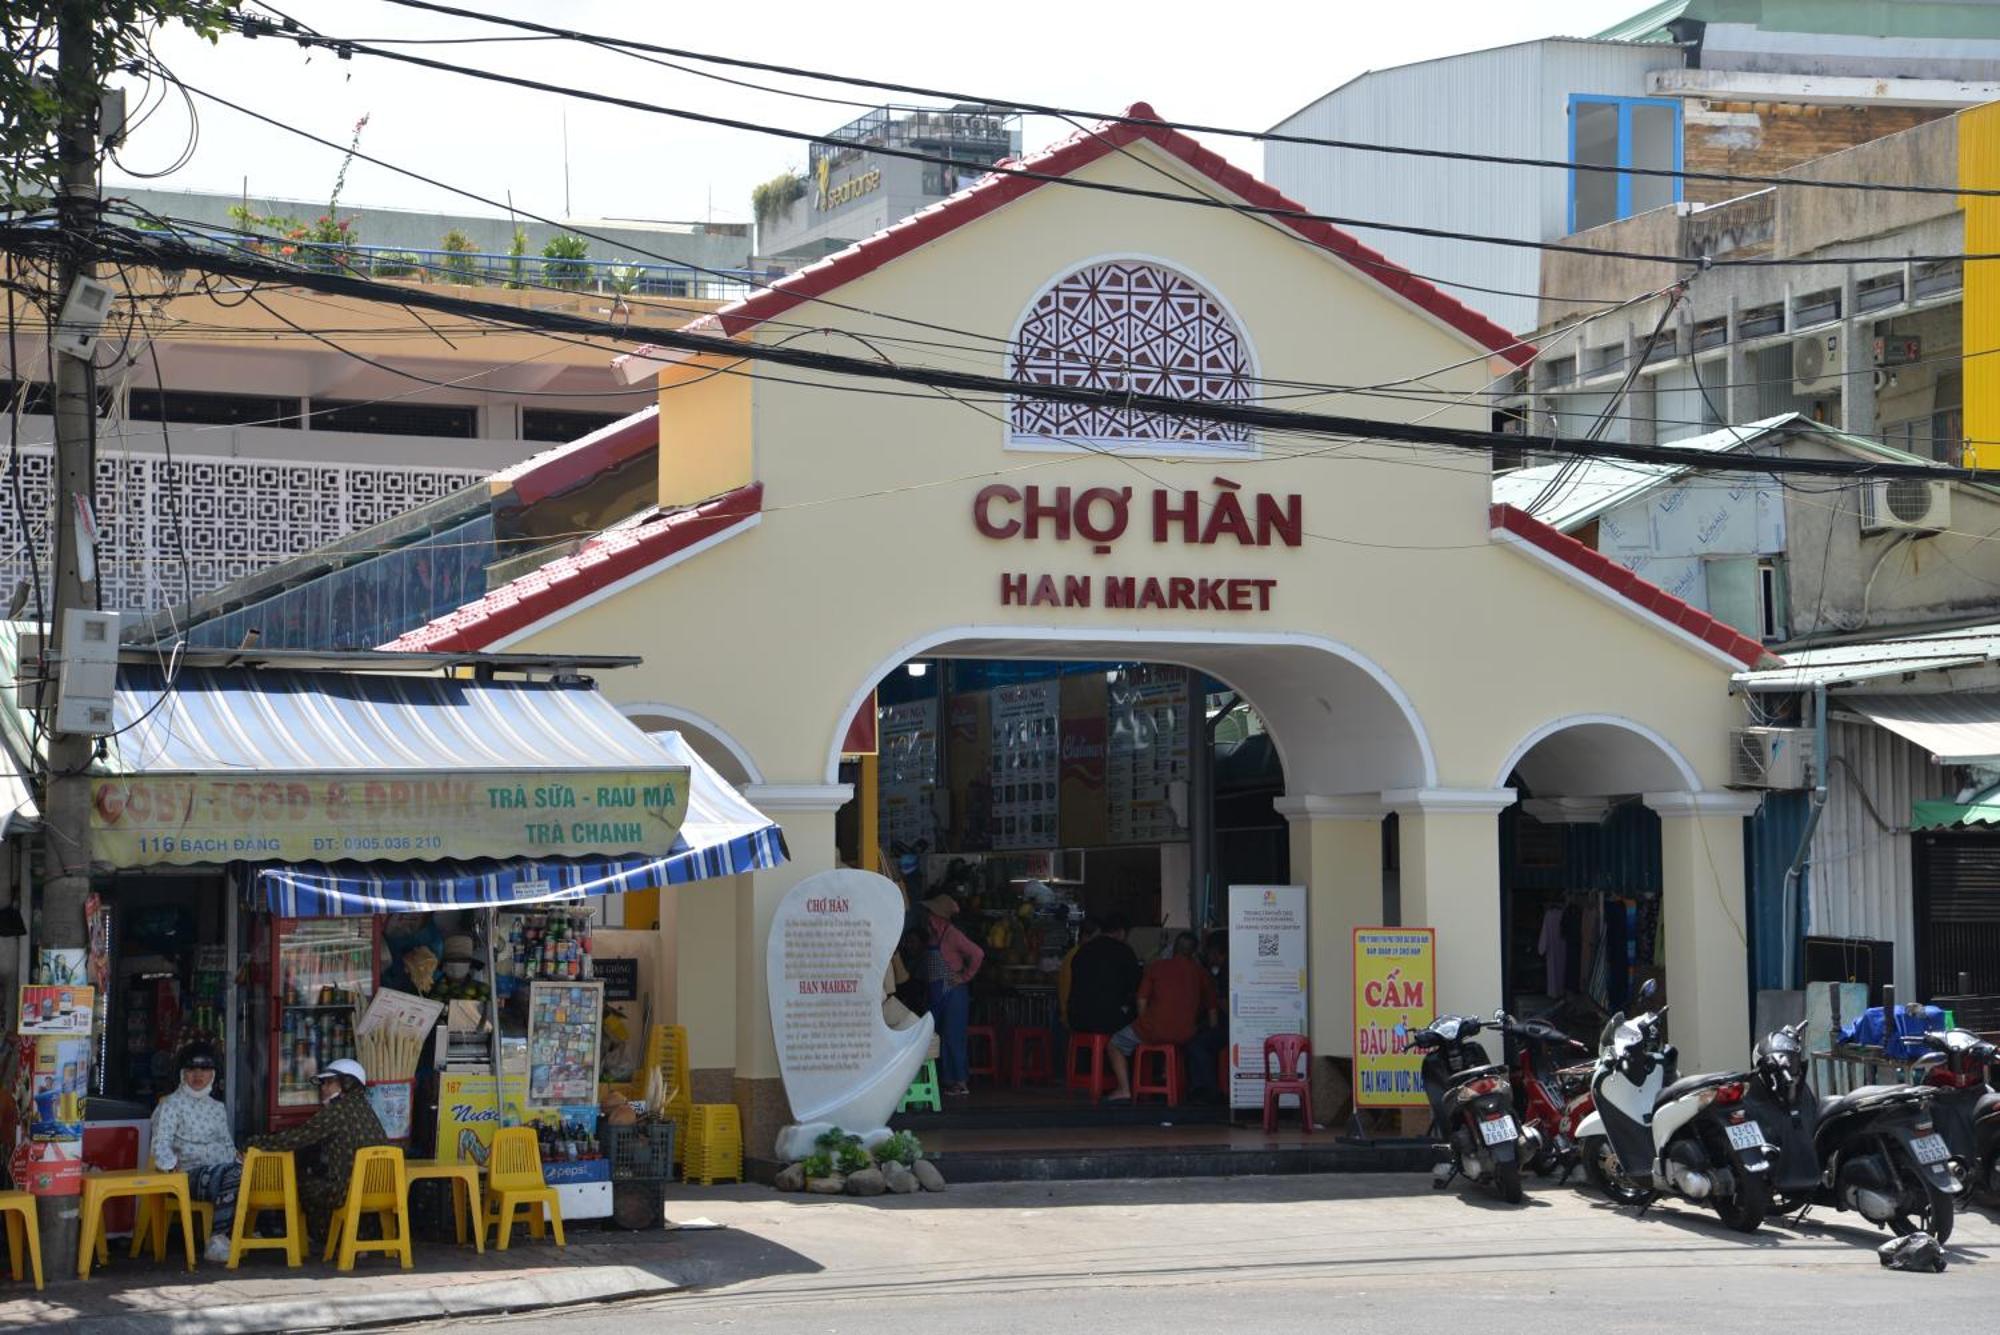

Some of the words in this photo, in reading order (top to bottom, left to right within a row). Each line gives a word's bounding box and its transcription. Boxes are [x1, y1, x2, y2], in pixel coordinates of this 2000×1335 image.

[829, 168, 881, 209] seahorse
[974, 484, 1133, 554] CHỢ
[1152, 476, 1302, 547] HÀN
[1001, 572, 1091, 608] HAN
[1104, 575, 1277, 611] MARKET
[487, 783, 527, 808] TRÀ
[534, 784, 575, 808] SỮA
[597, 787, 635, 808] RAU
[643, 782, 676, 807] MÁ
[139, 836, 175, 853] 116
[415, 836, 442, 849] 210
[525, 819, 565, 844] TRÀ
[572, 822, 642, 844] CHANH
[806, 897, 827, 914] CHỢ
[829, 896, 849, 913] HÀN
[799, 981, 818, 994] HAN
[820, 980, 859, 993] MARKET
[1364, 968, 1424, 1008] CẤM
[1360, 1020, 1388, 1062] ĐẬU
[1361, 1070, 1374, 1098] TẠI
[1376, 1070, 1393, 1093] KHU
[557, 1165, 588, 1178] pepsi
